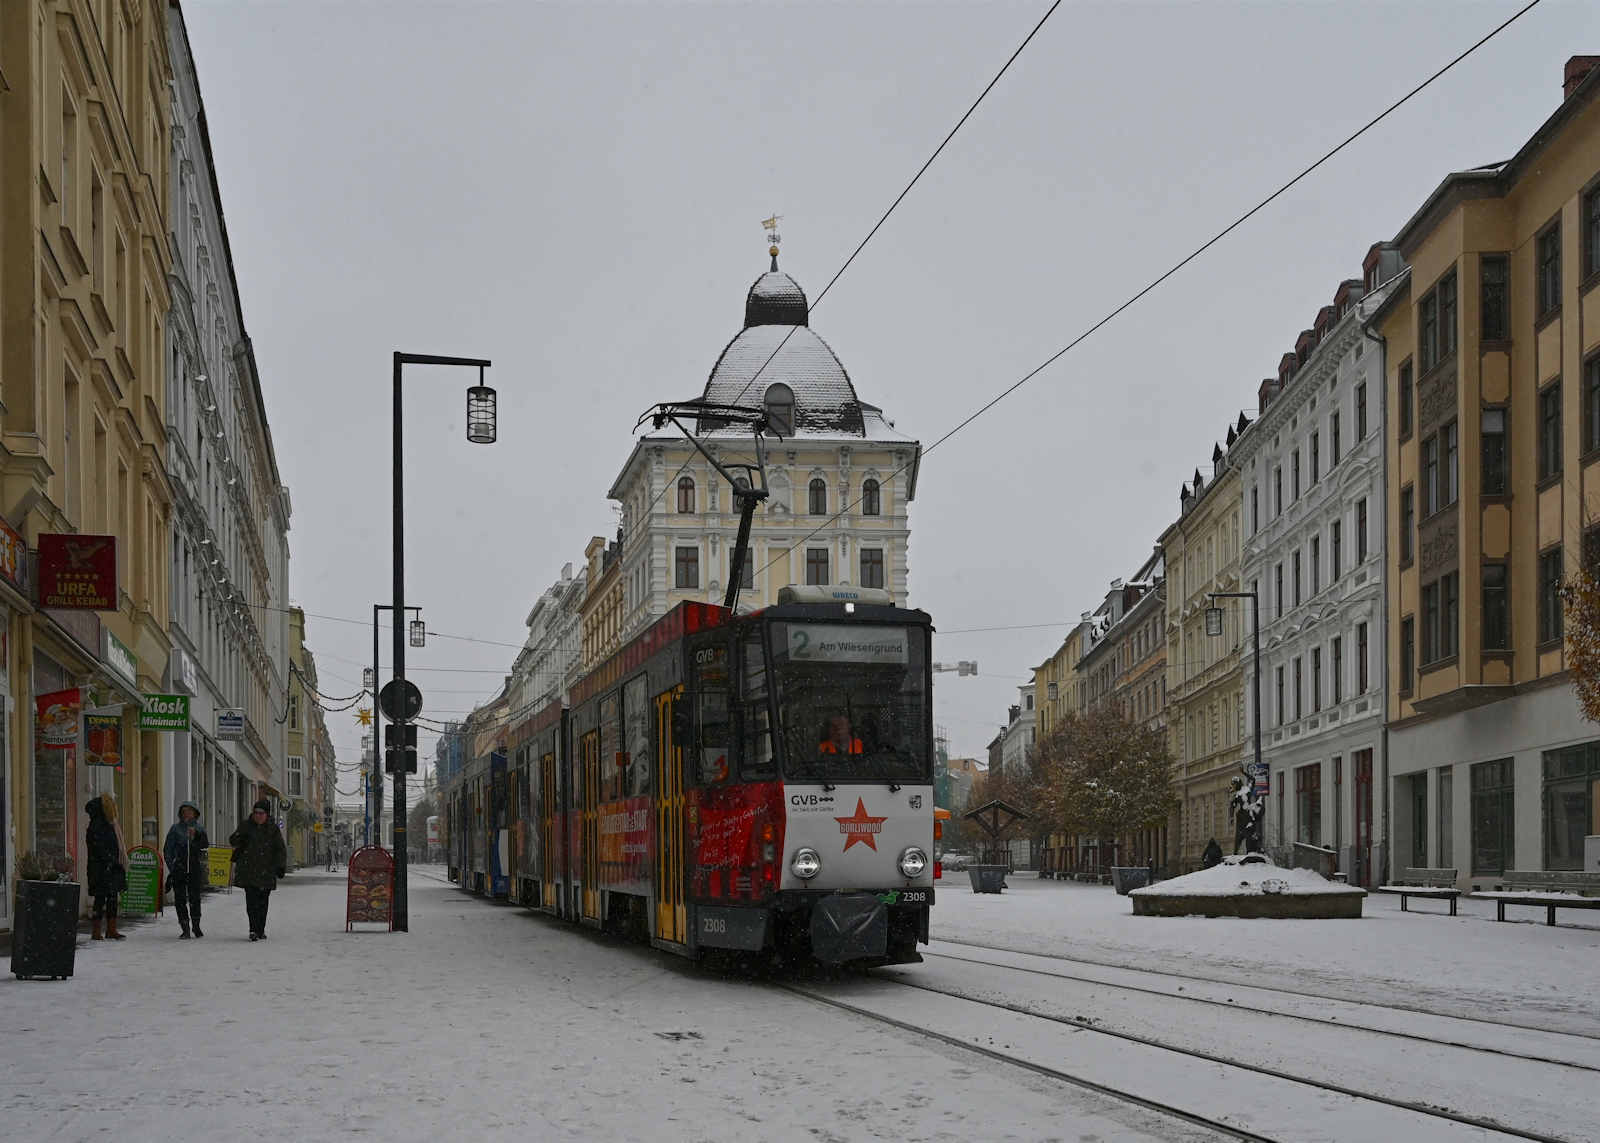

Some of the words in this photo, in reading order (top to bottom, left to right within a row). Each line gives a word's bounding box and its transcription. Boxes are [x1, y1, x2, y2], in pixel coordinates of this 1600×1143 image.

[57, 582, 97, 596] URFA
[46, 595, 74, 605] GRILL
[76, 597, 108, 606] KEBAB
[832, 592, 859, 600] WAECO
[792, 630, 811, 659] 2
[819, 642, 836, 651] Am
[838, 643, 903, 655] Wiesengrund
[696, 648, 714, 664] GVB
[142, 697, 186, 714] Kiosk
[141, 716, 187, 727] Minimarkt
[791, 795, 818, 805] GVB
[840, 821, 882, 834] GÖRLIWOOD
[131, 851, 154, 861] Kiosk
[903, 892, 926, 902] 2308
[703, 917, 726, 933] 2308
